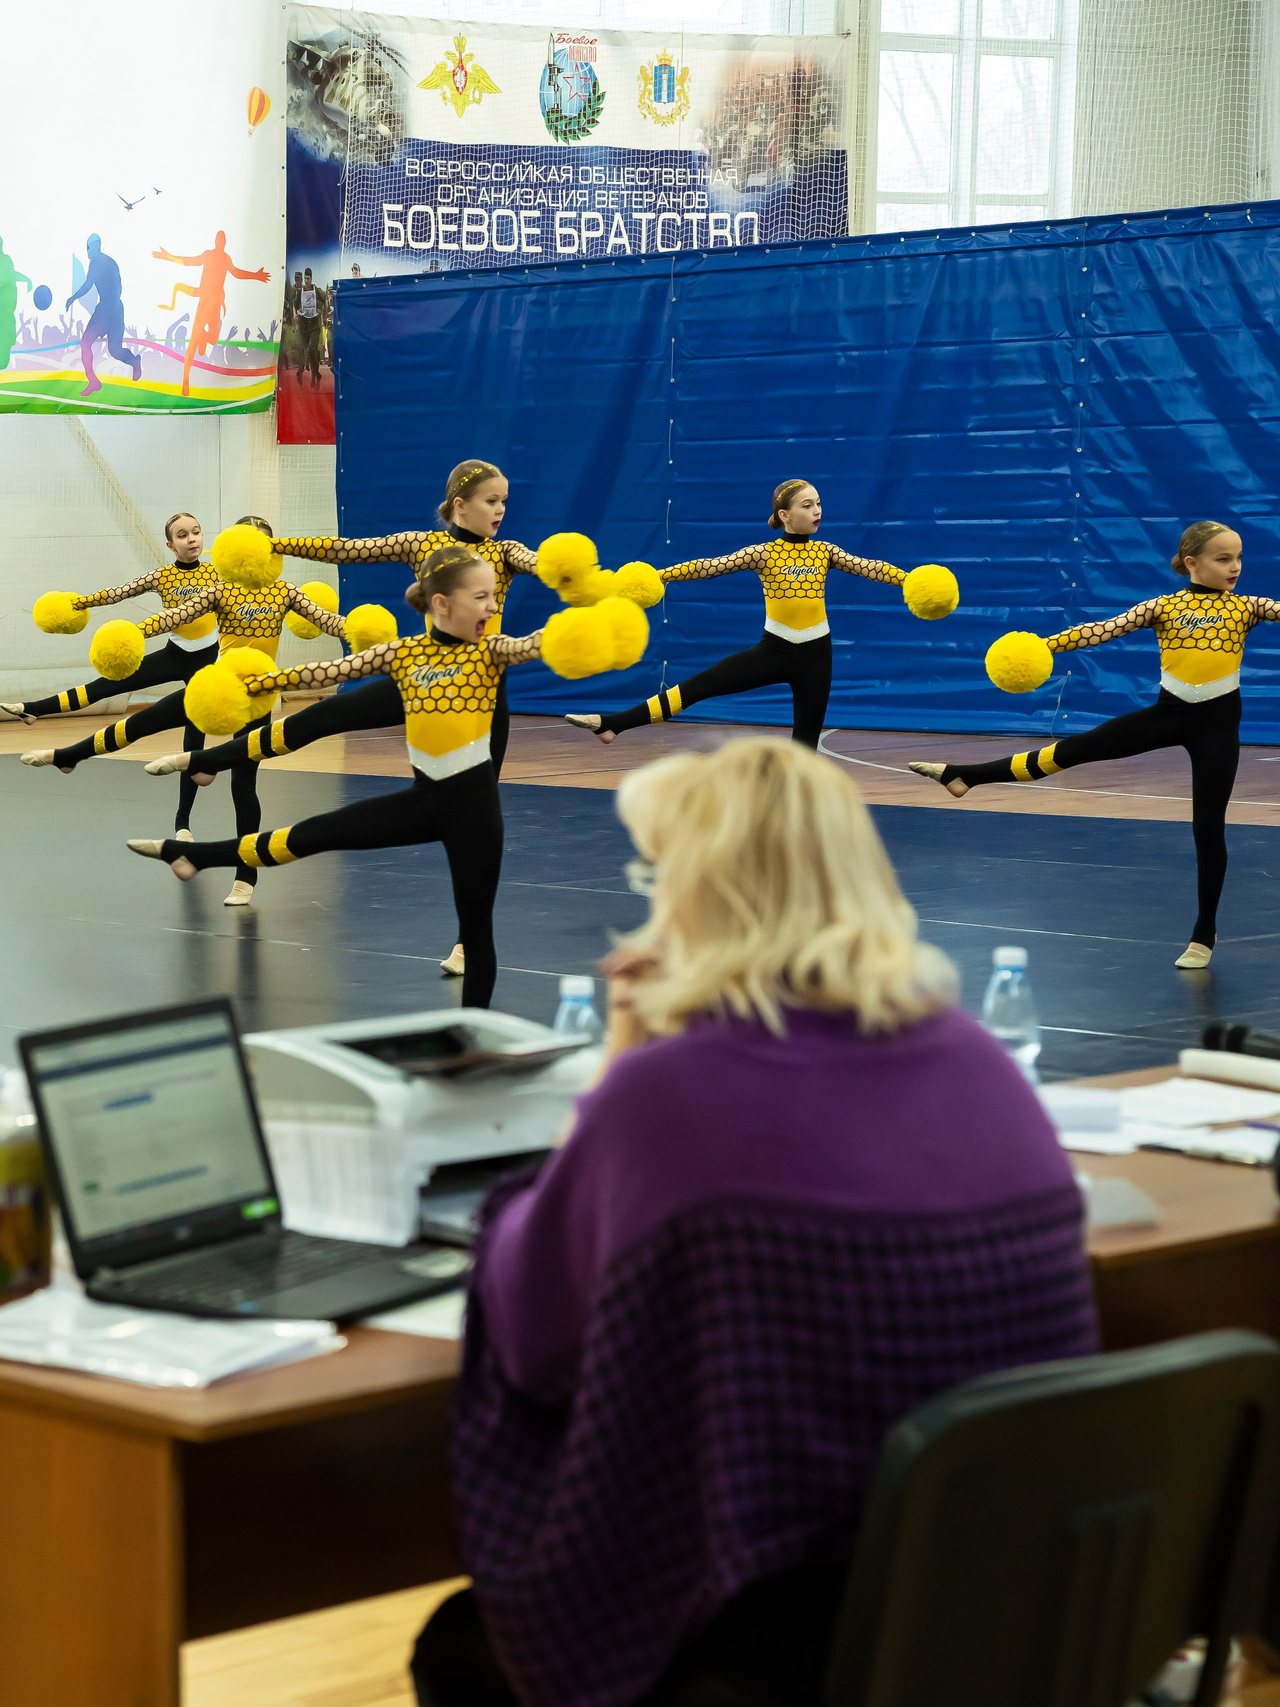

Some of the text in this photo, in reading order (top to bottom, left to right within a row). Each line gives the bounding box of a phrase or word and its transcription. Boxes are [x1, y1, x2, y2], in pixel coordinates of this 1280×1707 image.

[555, 32, 598, 45] Боевое
[405, 158, 739, 188] ВСЕРОССИЙКАЯ ОБЩЕСТВЕННАЯ
[437, 184, 709, 211] ОРГАНИЗАЦИЯ ВЕТЕРАНОВ
[382, 203, 759, 254] БОЕВОЕ БРАТСТВО
[782, 565, 818, 581] Идеал
[235, 604, 273, 622] Идеал
[1174, 612, 1224, 634] Идеал
[410, 664, 462, 690] Идеал
